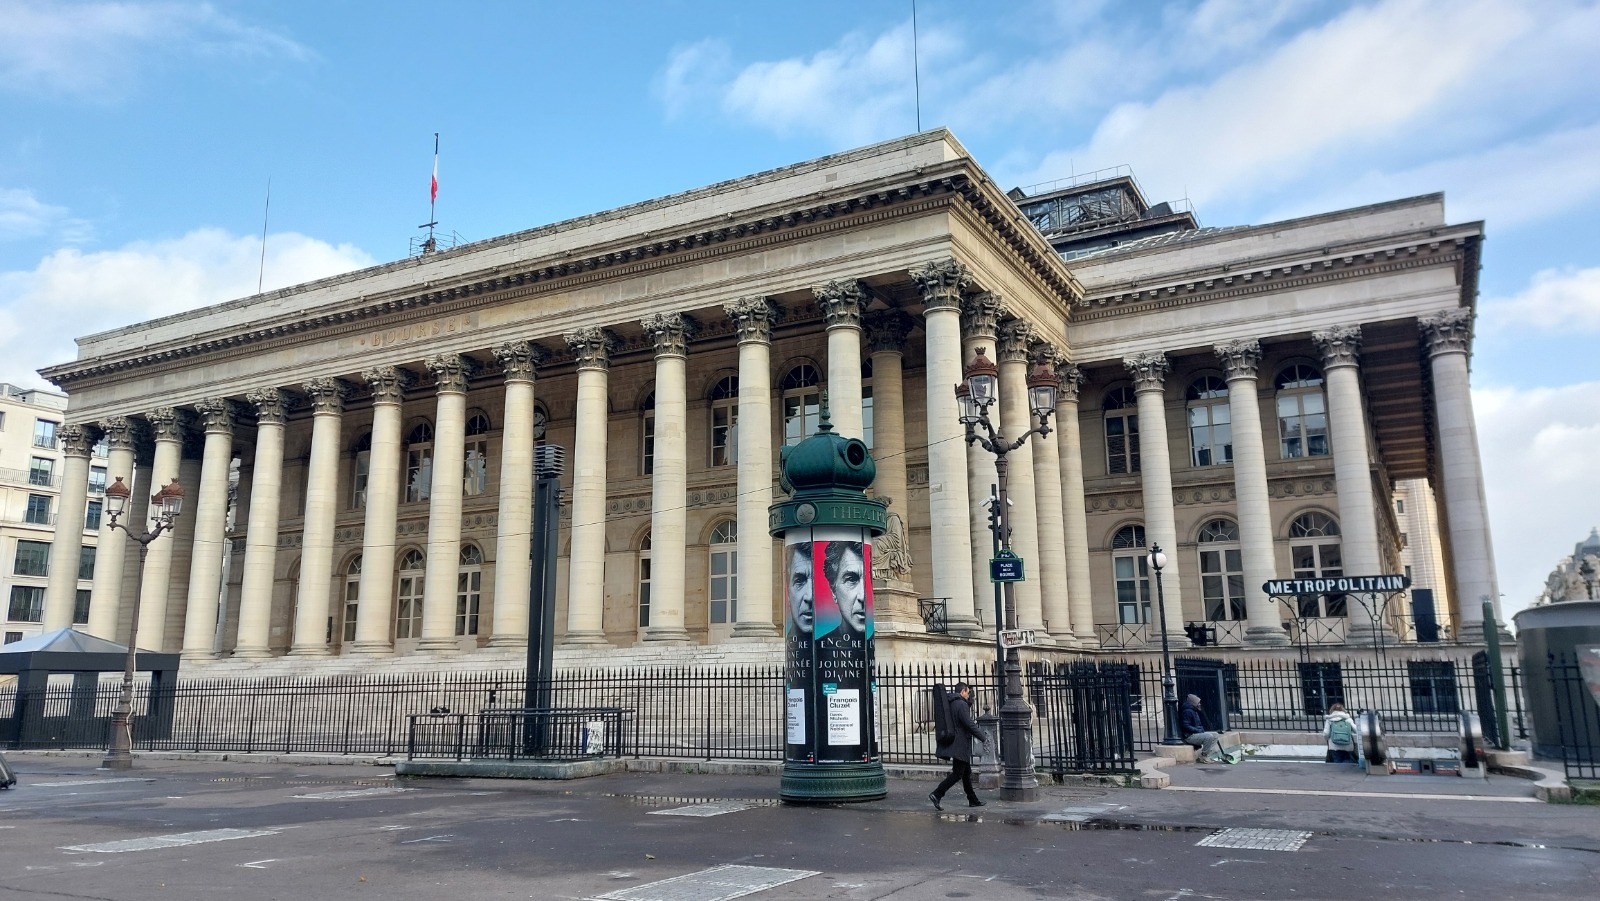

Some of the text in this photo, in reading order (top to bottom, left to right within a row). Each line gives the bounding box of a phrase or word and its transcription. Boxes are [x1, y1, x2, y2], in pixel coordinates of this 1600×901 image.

[371, 317, 457, 346] BOURSE
[1269, 576, 1404, 594] METROPOLITAIN
[820, 633, 862, 648] ENCORE
[832, 650, 853, 658] UNE
[819, 658, 864, 668] JOURNÉE
[824, 670, 860, 682] DIVINE
